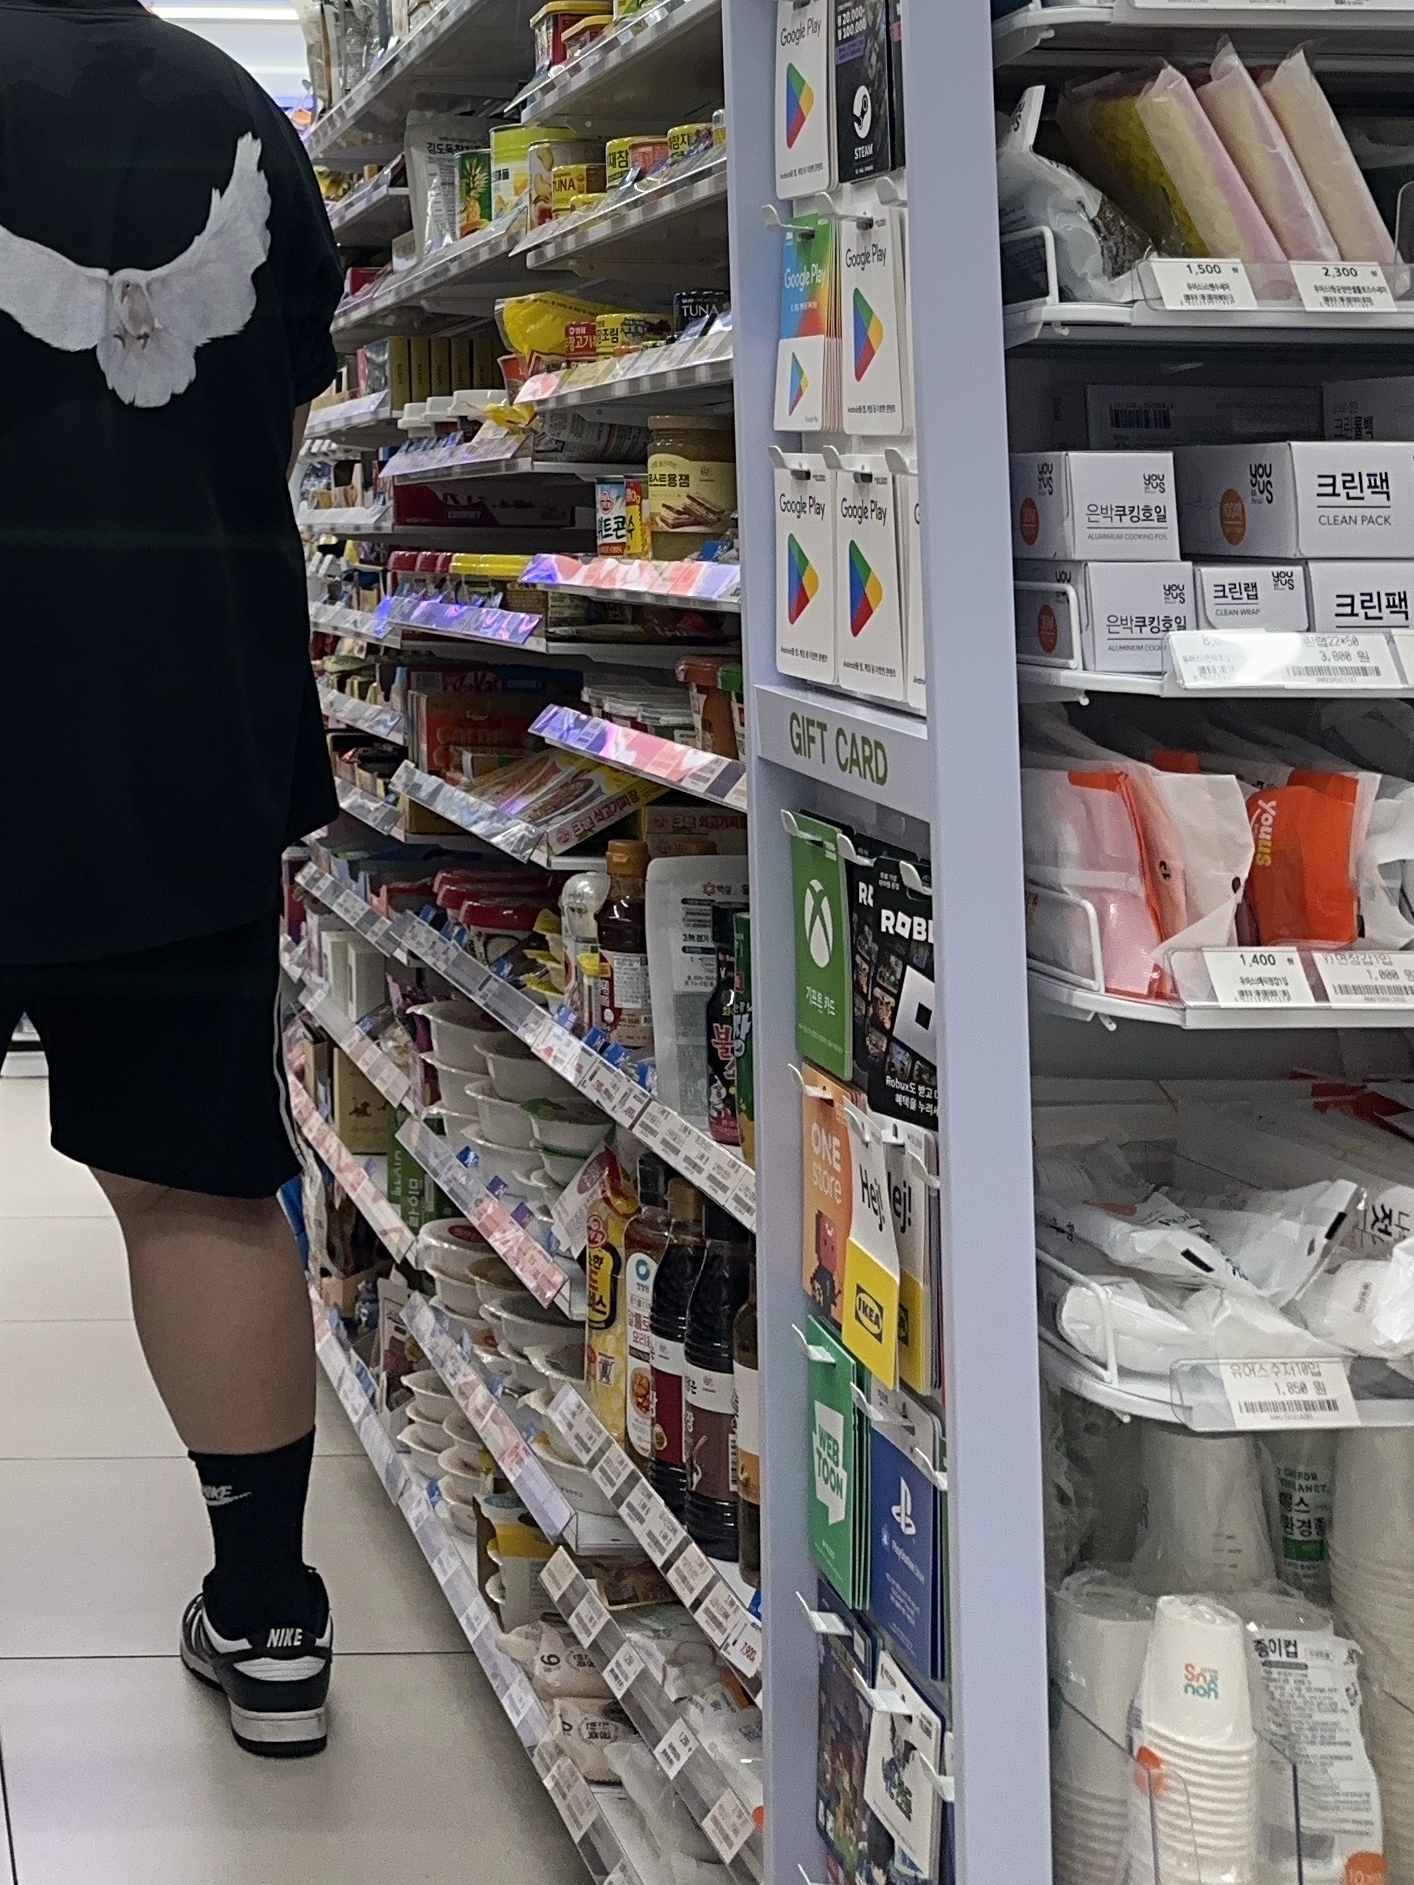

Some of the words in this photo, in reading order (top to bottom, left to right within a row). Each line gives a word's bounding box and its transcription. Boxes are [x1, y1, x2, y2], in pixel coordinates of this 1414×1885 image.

[780, 19, 807, 48] Google
[806, 14, 823, 38] Play
[854, 142, 874, 161] STEAM
[551, 177, 576, 194] TUNA
[845, 244, 870, 270] Google
[871, 242, 887, 267] Play
[784, 268, 810, 292] Google
[811, 265, 827, 289] Play
[1186, 263, 1222, 276] 1,500
[1321, 266, 1358, 278] 2,300
[682, 303, 720, 318] TUNA
[1316, 471, 1393, 502] 크린팩
[779, 492, 808, 518] Google
[808, 496, 826, 521] Play
[840, 497, 870, 523] Google
[869, 502, 888, 530] Play
[1085, 502, 1169, 524] 은박쿠킹호일
[1318, 514, 1357, 527] CLEAN
[1360, 513, 1393, 527] PACK
[1213, 582, 1259, 601] 크린랩
[1215, 608, 1238, 617] CLEAN
[1238, 607, 1261, 616] WRAP
[1334, 590, 1410, 621] 크린팩
[1105, 614, 1188, 634] 은박쿠킹호일
[1356, 651, 1371, 663] 원
[789, 710, 828, 766] GIFT
[834, 720, 889, 787] CARD
[1239, 953, 1276, 968] 1,400
[809, 1121, 843, 1174] ONE
[811, 1166, 844, 1206] store
[858, 1163, 887, 1233] Hej!
[857, 1294, 883, 1331] IKEA
[1314, 1380, 1328, 1396] 원
[815, 1424, 841, 1468] WEB
[815, 1451, 847, 1501] TOON
[266, 1627, 304, 1648] NIKE
